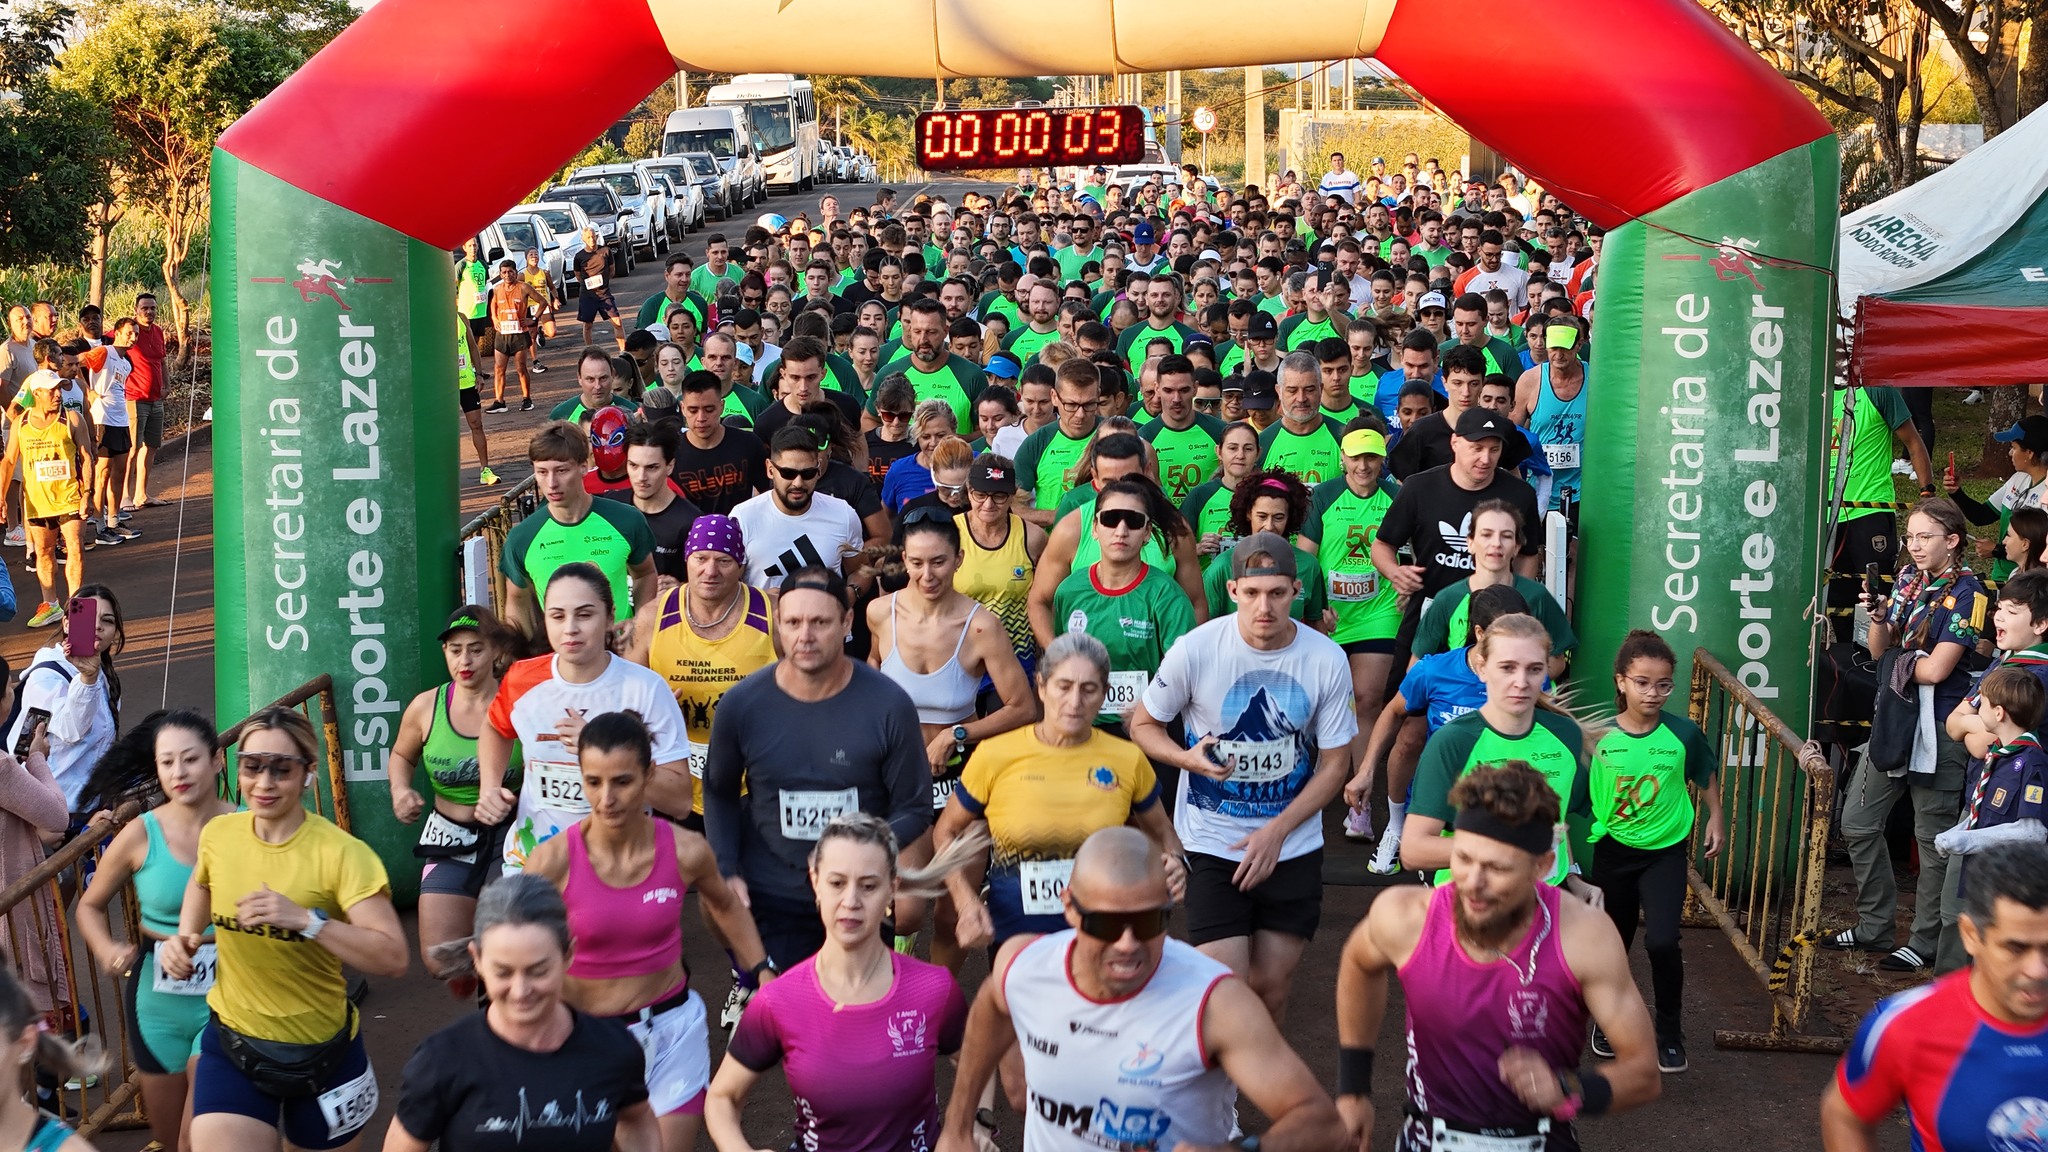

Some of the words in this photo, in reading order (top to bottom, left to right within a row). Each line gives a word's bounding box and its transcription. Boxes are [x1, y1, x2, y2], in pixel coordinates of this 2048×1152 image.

[925, 115, 981, 158] 00
[994, 112, 1050, 155] 00
[1064, 111, 1121, 153] 03
[1860, 214, 1939, 261] ARECHAL
[1661, 292, 1709, 360] de
[256, 314, 299, 382] de
[1734, 293, 1786, 463] Lazer
[333, 313, 380, 481] Lazer
[1549, 452, 1572, 463] 5156
[689, 471, 743, 492] ELEVEN
[1168, 463, 1202, 488] 50
[1652, 375, 1708, 633] Secretaria
[1744, 480, 1777, 518] e
[259, 396, 309, 652] Secretaria
[346, 499, 382, 536] e
[1342, 558, 1374, 566] ASSEM
[1435, 552, 1476, 570] adid
[1340, 582, 1370, 595] 1008
[338, 549, 400, 782] Esporte
[676, 659, 711, 667] KENIAN
[691, 667, 736, 675] RUNNERS
[669, 674, 750, 683] AZAMIGAKENIAN
[1106, 685, 1135, 703] 083
[690, 753, 706, 771] 53
[1238, 752, 1283, 772] 5143
[551, 779, 583, 801] 522
[1041, 879, 1064, 899] 50
